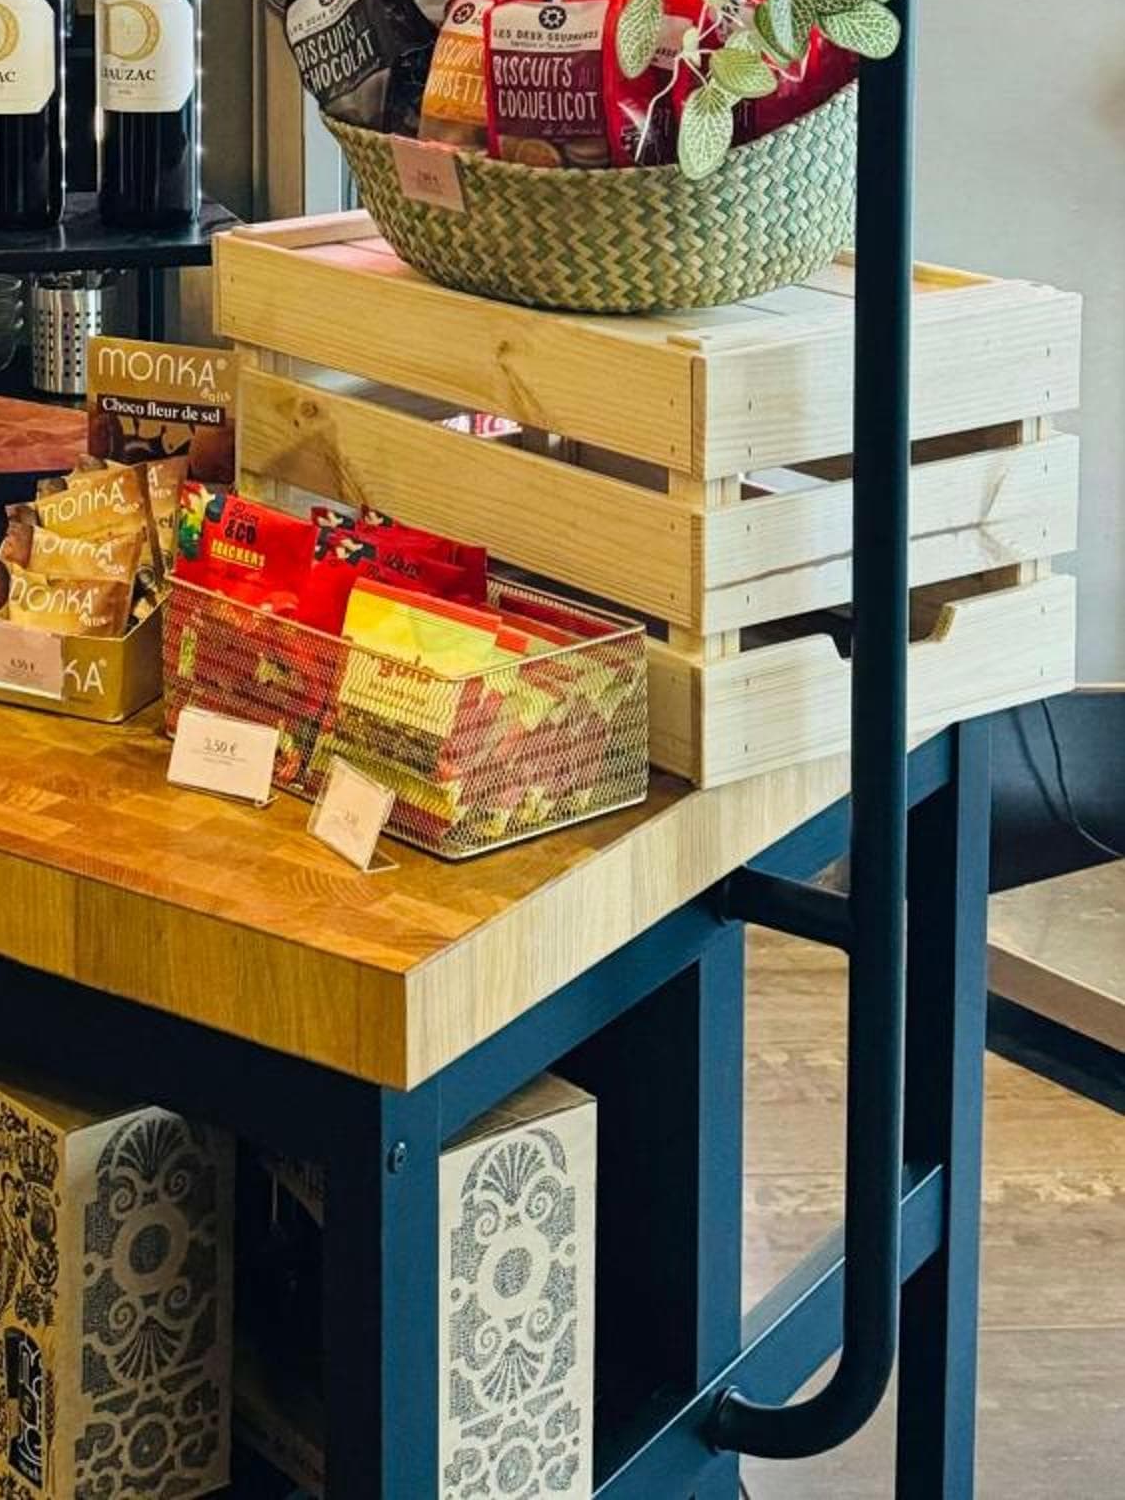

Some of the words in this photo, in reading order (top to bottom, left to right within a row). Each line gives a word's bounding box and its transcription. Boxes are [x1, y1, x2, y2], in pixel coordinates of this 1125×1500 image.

[293, 15, 357, 71] BISCUITS
[492, 54, 573, 88] BISCUITS
[497, 89, 598, 121] COQUELICOT
[97, 347, 217, 389] MONKA
[102, 396, 145, 416] Choco
[146, 401, 181, 418] fleur
[181, 405, 199, 422] de
[200, 408, 221, 424] sel
